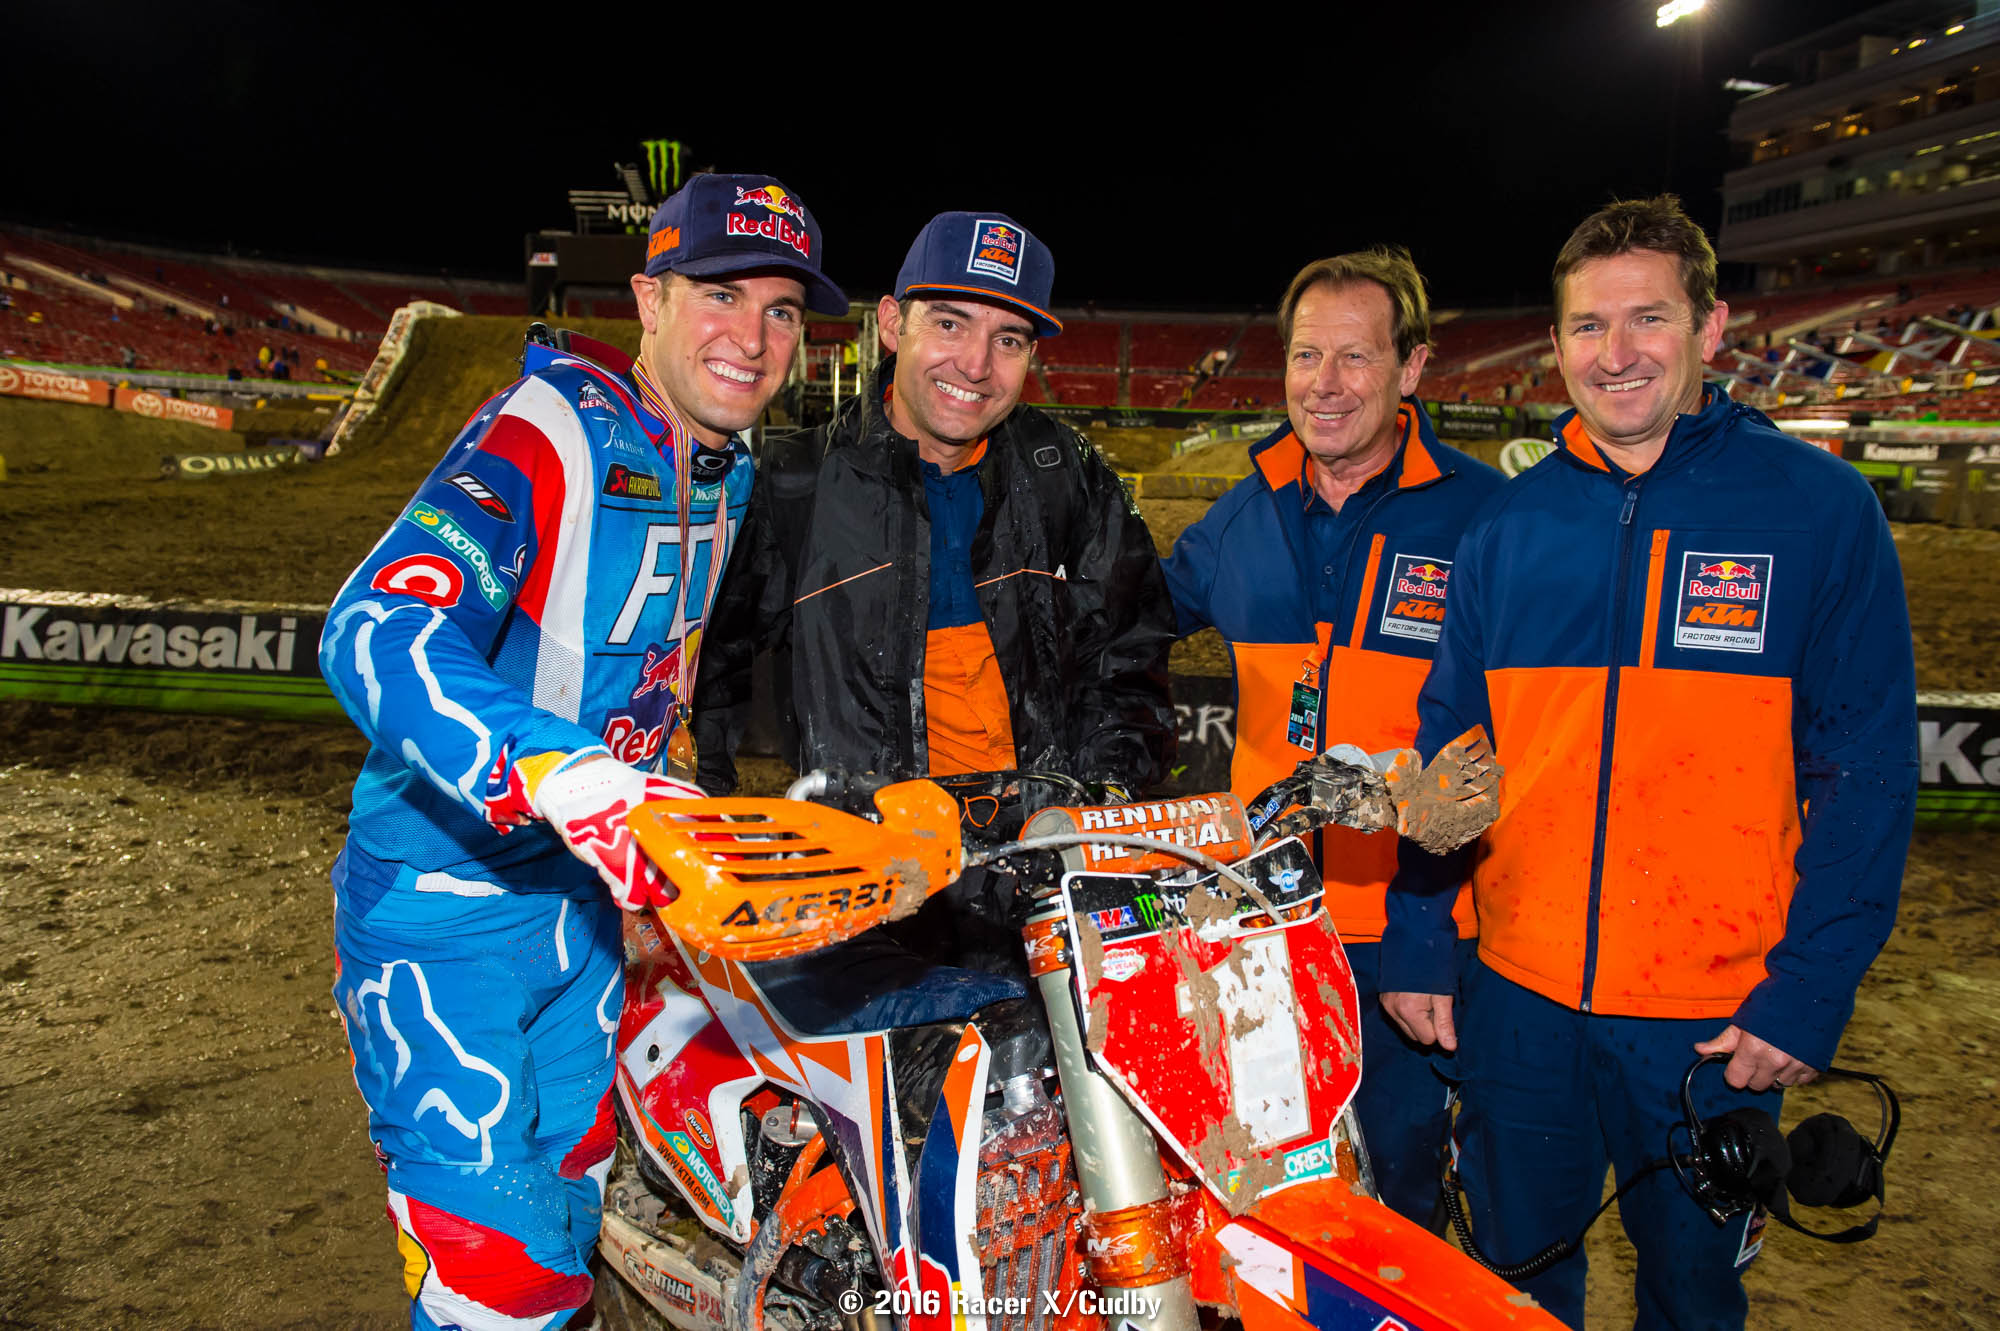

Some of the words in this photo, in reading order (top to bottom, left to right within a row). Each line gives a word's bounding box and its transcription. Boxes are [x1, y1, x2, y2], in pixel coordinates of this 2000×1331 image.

[727, 212, 777, 239] Red
[777, 218, 811, 259] Bull
[982, 235, 1001, 247] Red
[1001, 238, 1017, 253] Bull
[979, 247, 1015, 266] KTM
[23, 371, 90, 392] TOYOTA
[166, 400, 218, 419] TOYOTA
[438, 522, 502, 600] MOTOREX
[1397, 578, 1425, 596] Red
[1425, 582, 1447, 599] Bul
[1689, 580, 1725, 598] Red
[1725, 582, 1760, 600] Bull
[1392, 599, 1446, 622] KTM
[1685, 602, 1758, 627] KTM
[1, 606, 297, 671] Kawasaki
[1387, 622, 1418, 632] FACTORY
[1419, 626, 1441, 636] RACIN
[1682, 633, 1721, 642] FACTORY
[1723, 636, 1756, 645] RACING
[721, 879, 894, 926] ACERBI
[1088, 906, 1137, 930] AMA
[687, 1114, 703, 1134] Twin
[701, 1131, 713, 1146] Air
[1283, 1144, 1329, 1177] OREX
[657, 1142, 710, 1210] WWW.KTM.COM
[687, 1150, 733, 1221] MOTOREX
[646, 1266, 695, 1304] ENTHAL
